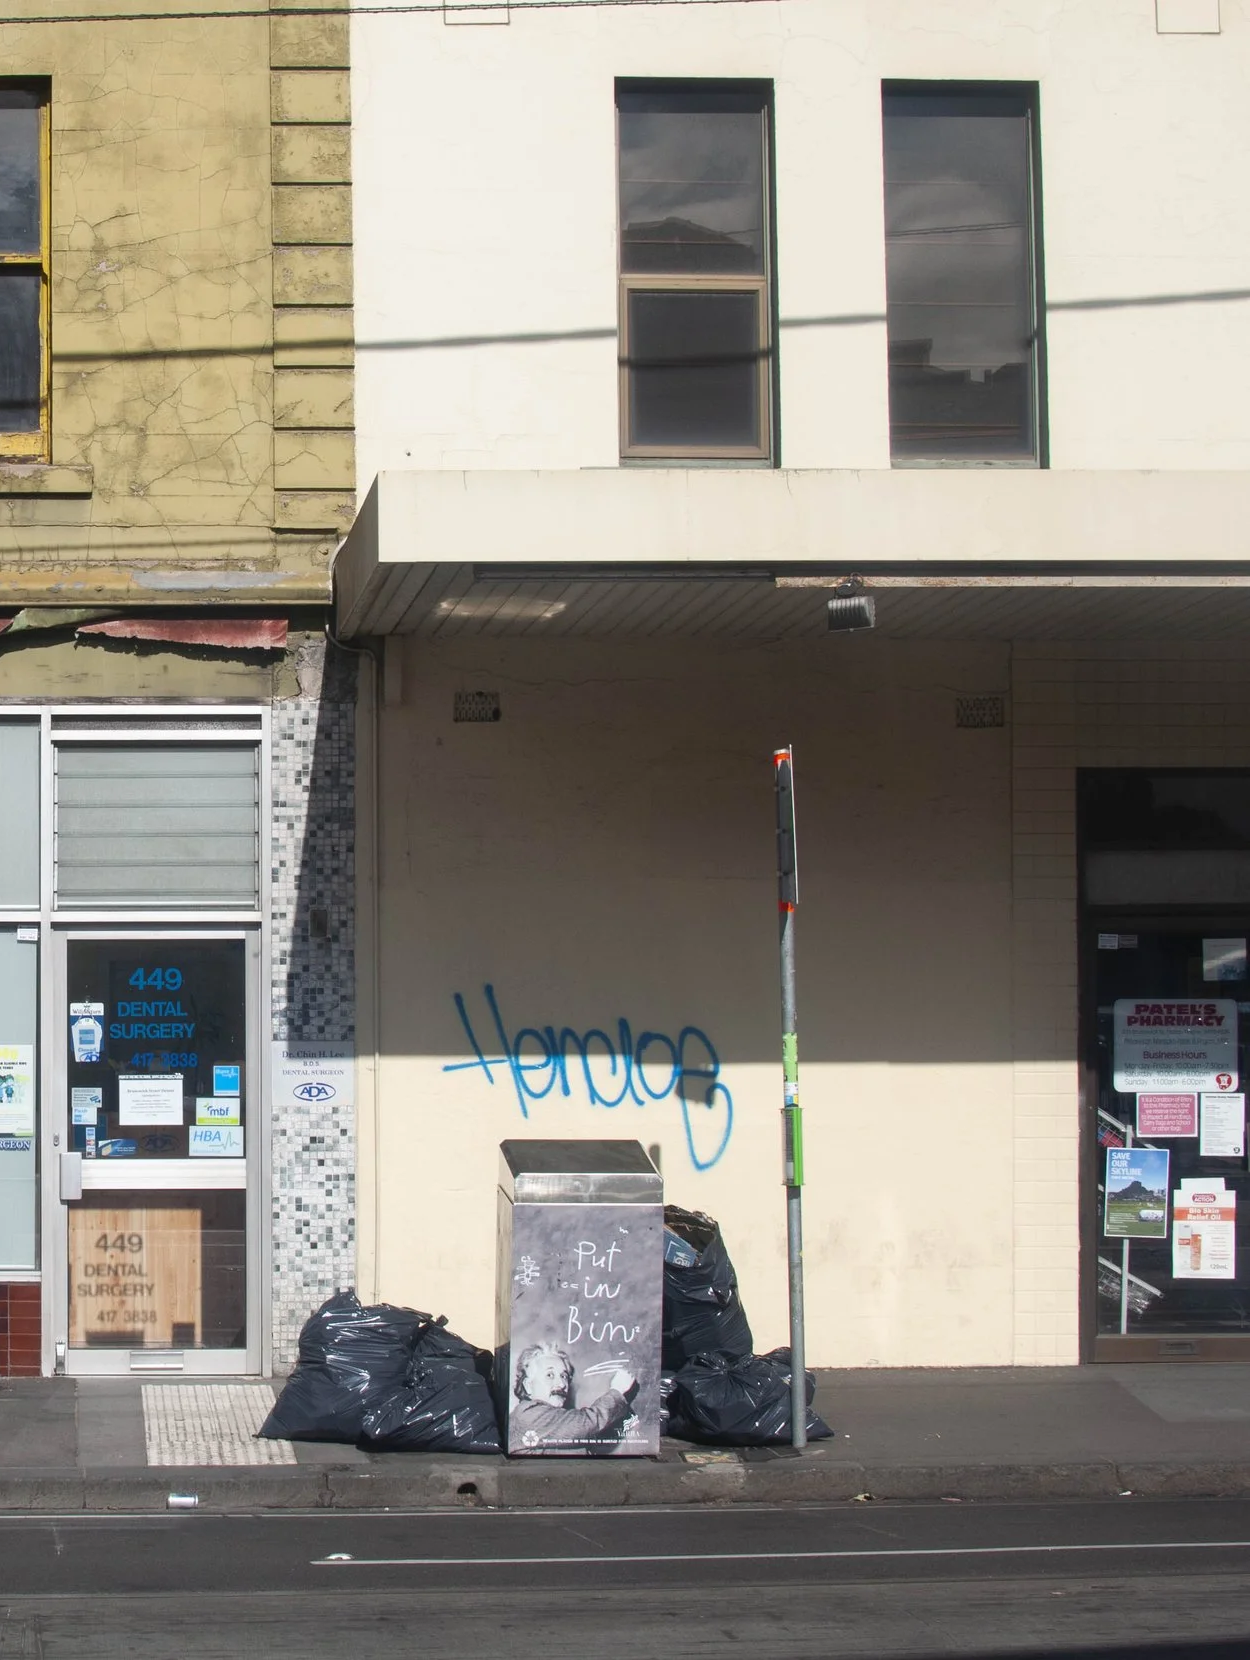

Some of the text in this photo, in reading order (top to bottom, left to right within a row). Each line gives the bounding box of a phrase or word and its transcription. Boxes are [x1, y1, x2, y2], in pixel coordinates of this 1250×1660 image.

[129, 967, 183, 991] 449
[117, 1001, 188, 1017] DENTAL
[1134, 1004, 1217, 1015] PATEL'S
[1126, 1016, 1225, 1026] PHARMACY
[110, 1023, 196, 1039] SURGERY
[161, 1052, 198, 1068] 3838
[296, 1050, 318, 1058] Chin
[300, 1086, 329, 1098] ADA
[210, 1107, 230, 1116] mbf
[193, 1131, 222, 1141] HBA
[1111, 1152, 1131, 1160] SAVE
[1111, 1160, 1127, 1168] OUR
[1111, 1168, 1142, 1176] SKYLINE
[95, 1233, 143, 1253] 449
[574, 1241, 621, 1272] Put
[83, 1264, 147, 1277] DENTAL
[77, 1283, 154, 1297] SURGERY
[584, 1276, 620, 1298] in
